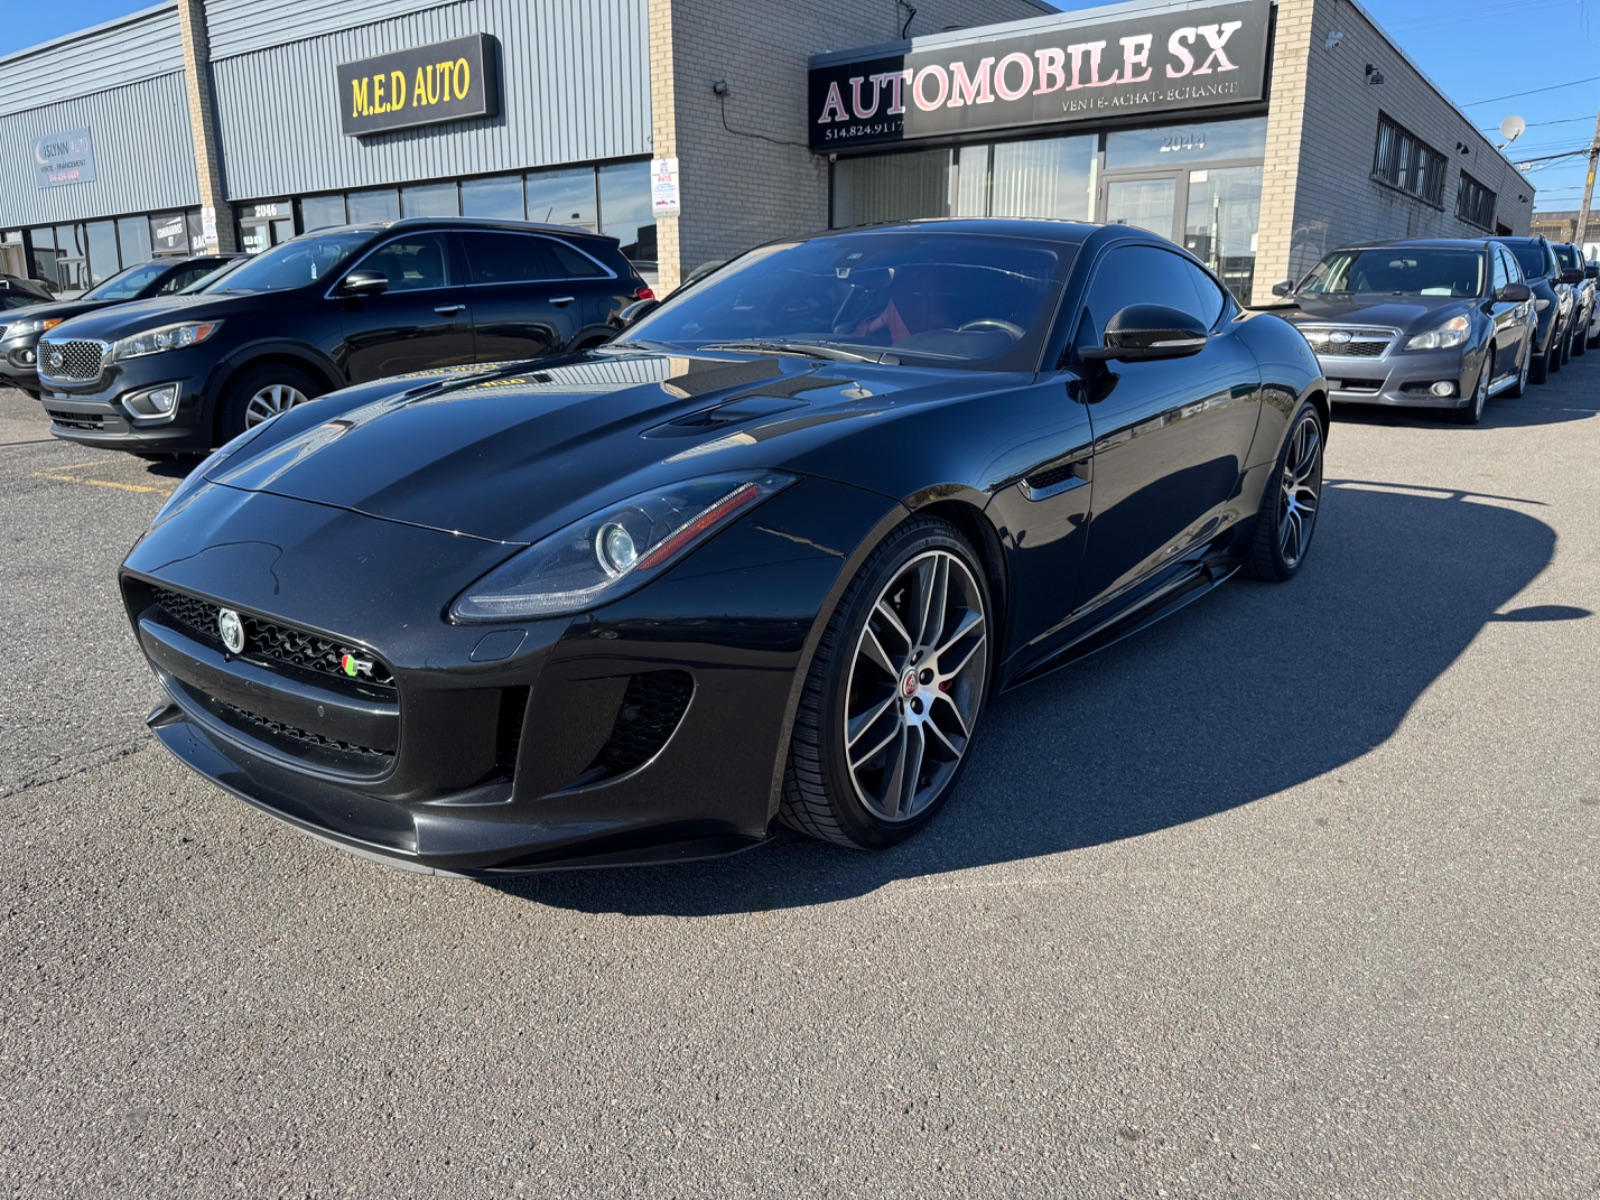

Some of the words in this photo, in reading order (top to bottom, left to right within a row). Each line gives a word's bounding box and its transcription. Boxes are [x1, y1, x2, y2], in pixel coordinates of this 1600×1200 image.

[818, 33, 1153, 124] AUTOMOBILE
[1166, 20, 1242, 79] SX
[352, 70, 407, 118] M.E.D
[413, 57, 471, 108] AUTO
[825, 121, 905, 141] 514.824.9117
[1159, 132, 1207, 152] 2044
[254, 203, 278, 218] 2046
[353, 659, 374, 677] R
